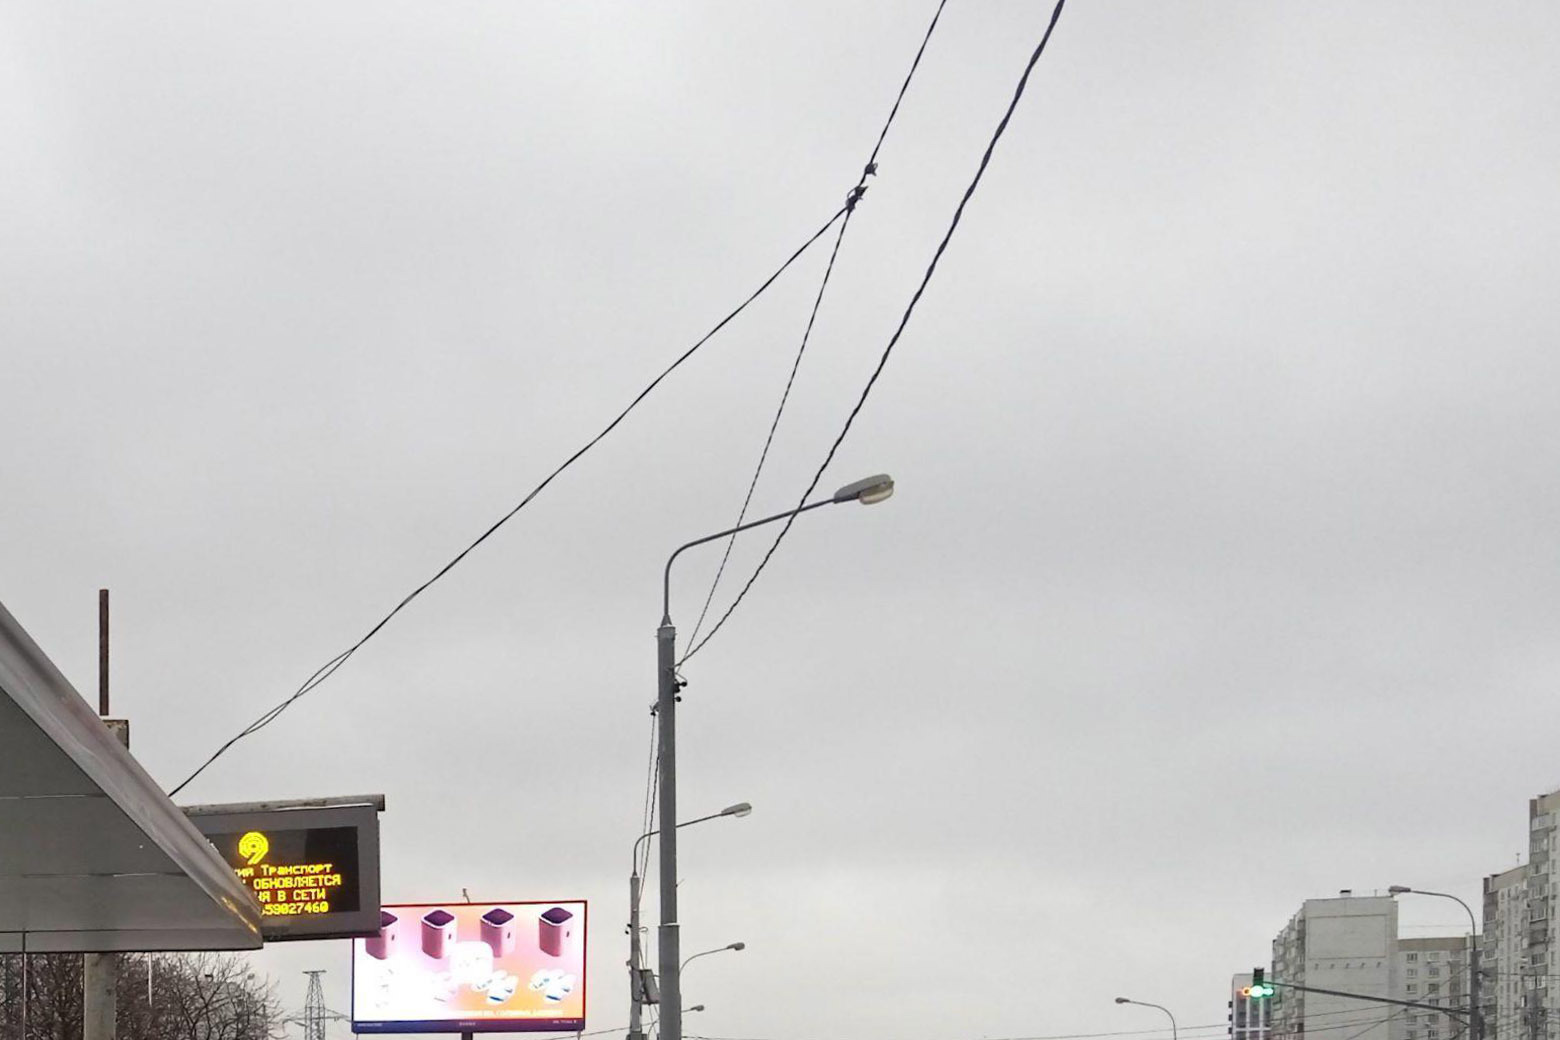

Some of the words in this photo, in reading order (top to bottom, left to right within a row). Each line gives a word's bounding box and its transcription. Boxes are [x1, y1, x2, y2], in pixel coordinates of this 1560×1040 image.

[261, 864, 332, 876] Транспорт
[253, 874, 341, 889] ОБНОВЛЯЕТСЯ
[277, 890, 287, 902] В
[293, 888, 326, 901] СЕТИ
[262, 901, 329, 915] 59027460
